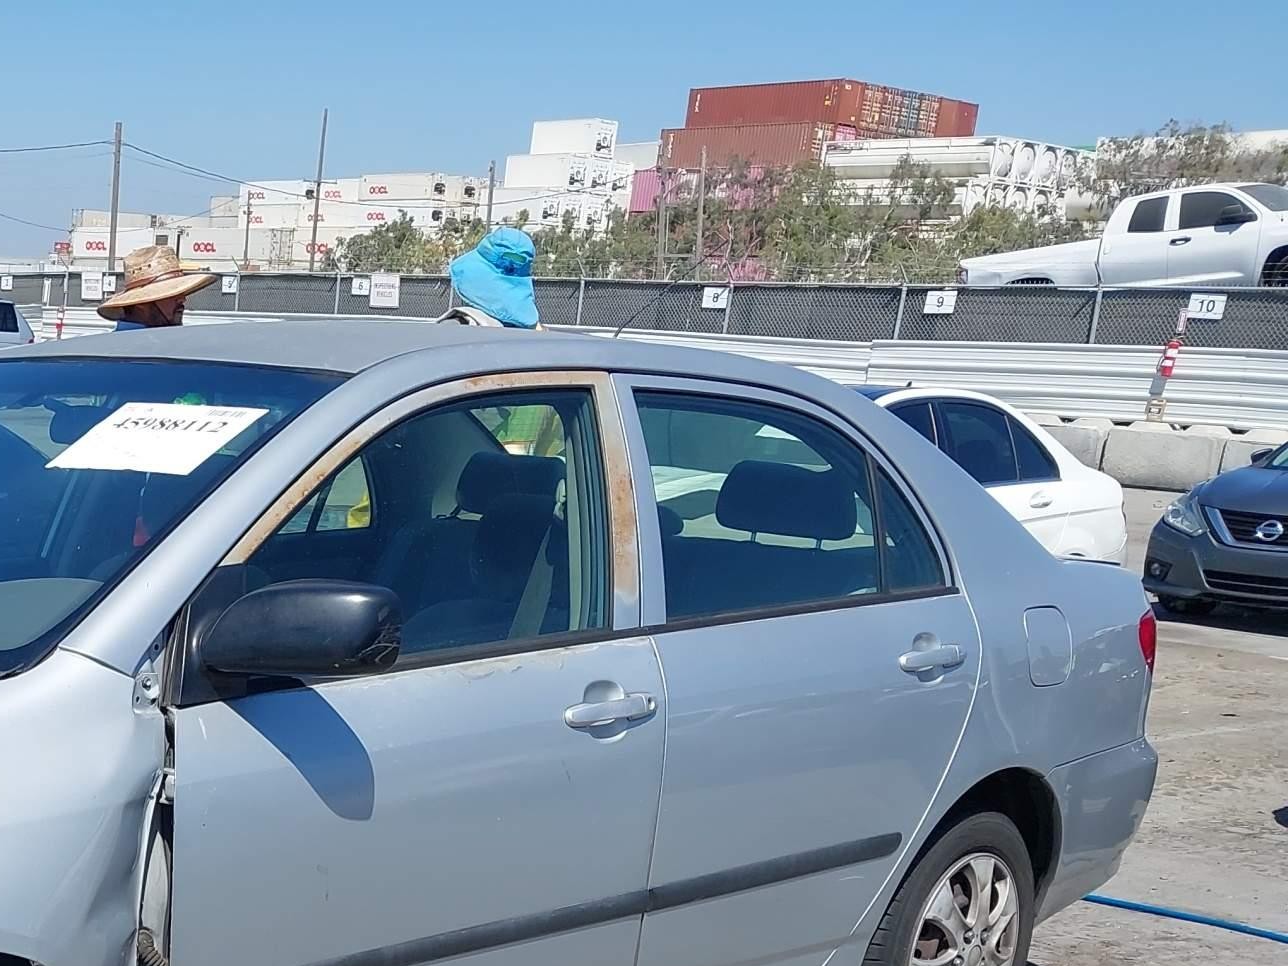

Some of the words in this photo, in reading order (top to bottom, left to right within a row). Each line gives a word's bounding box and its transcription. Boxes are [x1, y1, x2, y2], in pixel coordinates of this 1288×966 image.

[369, 185, 388, 194] OOCL
[367, 212, 385, 221] OOCL
[86, 241, 107, 251] OOCL
[193, 242, 216, 252] OOCL
[358, 281, 364, 290] 6
[712, 292, 719, 303] 8
[936, 296, 944, 308] 9
[1198, 299, 1215, 312] 10
[113, 416, 228, 433] 45988112
